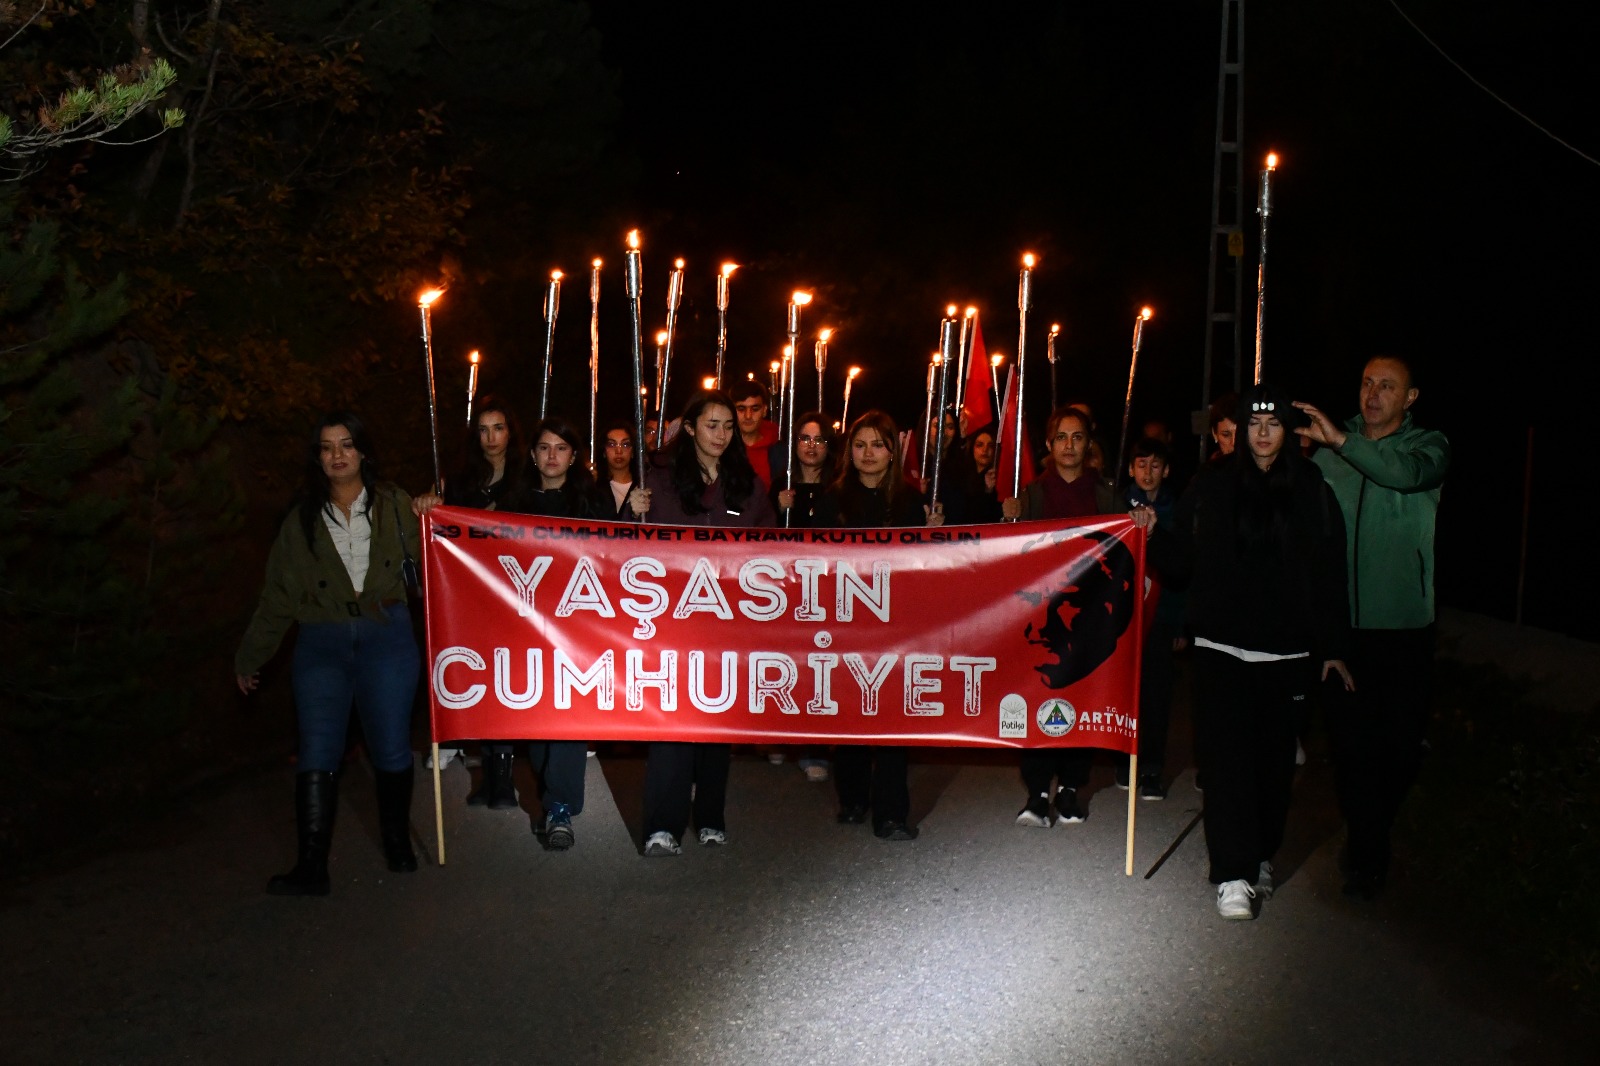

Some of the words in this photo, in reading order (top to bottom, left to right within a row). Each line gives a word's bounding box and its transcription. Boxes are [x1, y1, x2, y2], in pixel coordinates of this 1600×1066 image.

[431, 525, 462, 539] 29
[468, 523, 526, 541] EKİM
[532, 524, 687, 542] CUMHURİYET
[693, 529, 804, 543] BAYRAMI
[811, 531, 893, 544] KUTLU
[899, 531, 981, 546] OLSUN
[497, 554, 891, 641] YAŞASIN
[432, 630, 998, 717] CUMHURİYET
[1078, 724, 1137, 739] BELEDİYESİ
[1079, 711, 1137, 731] ARTVİN
